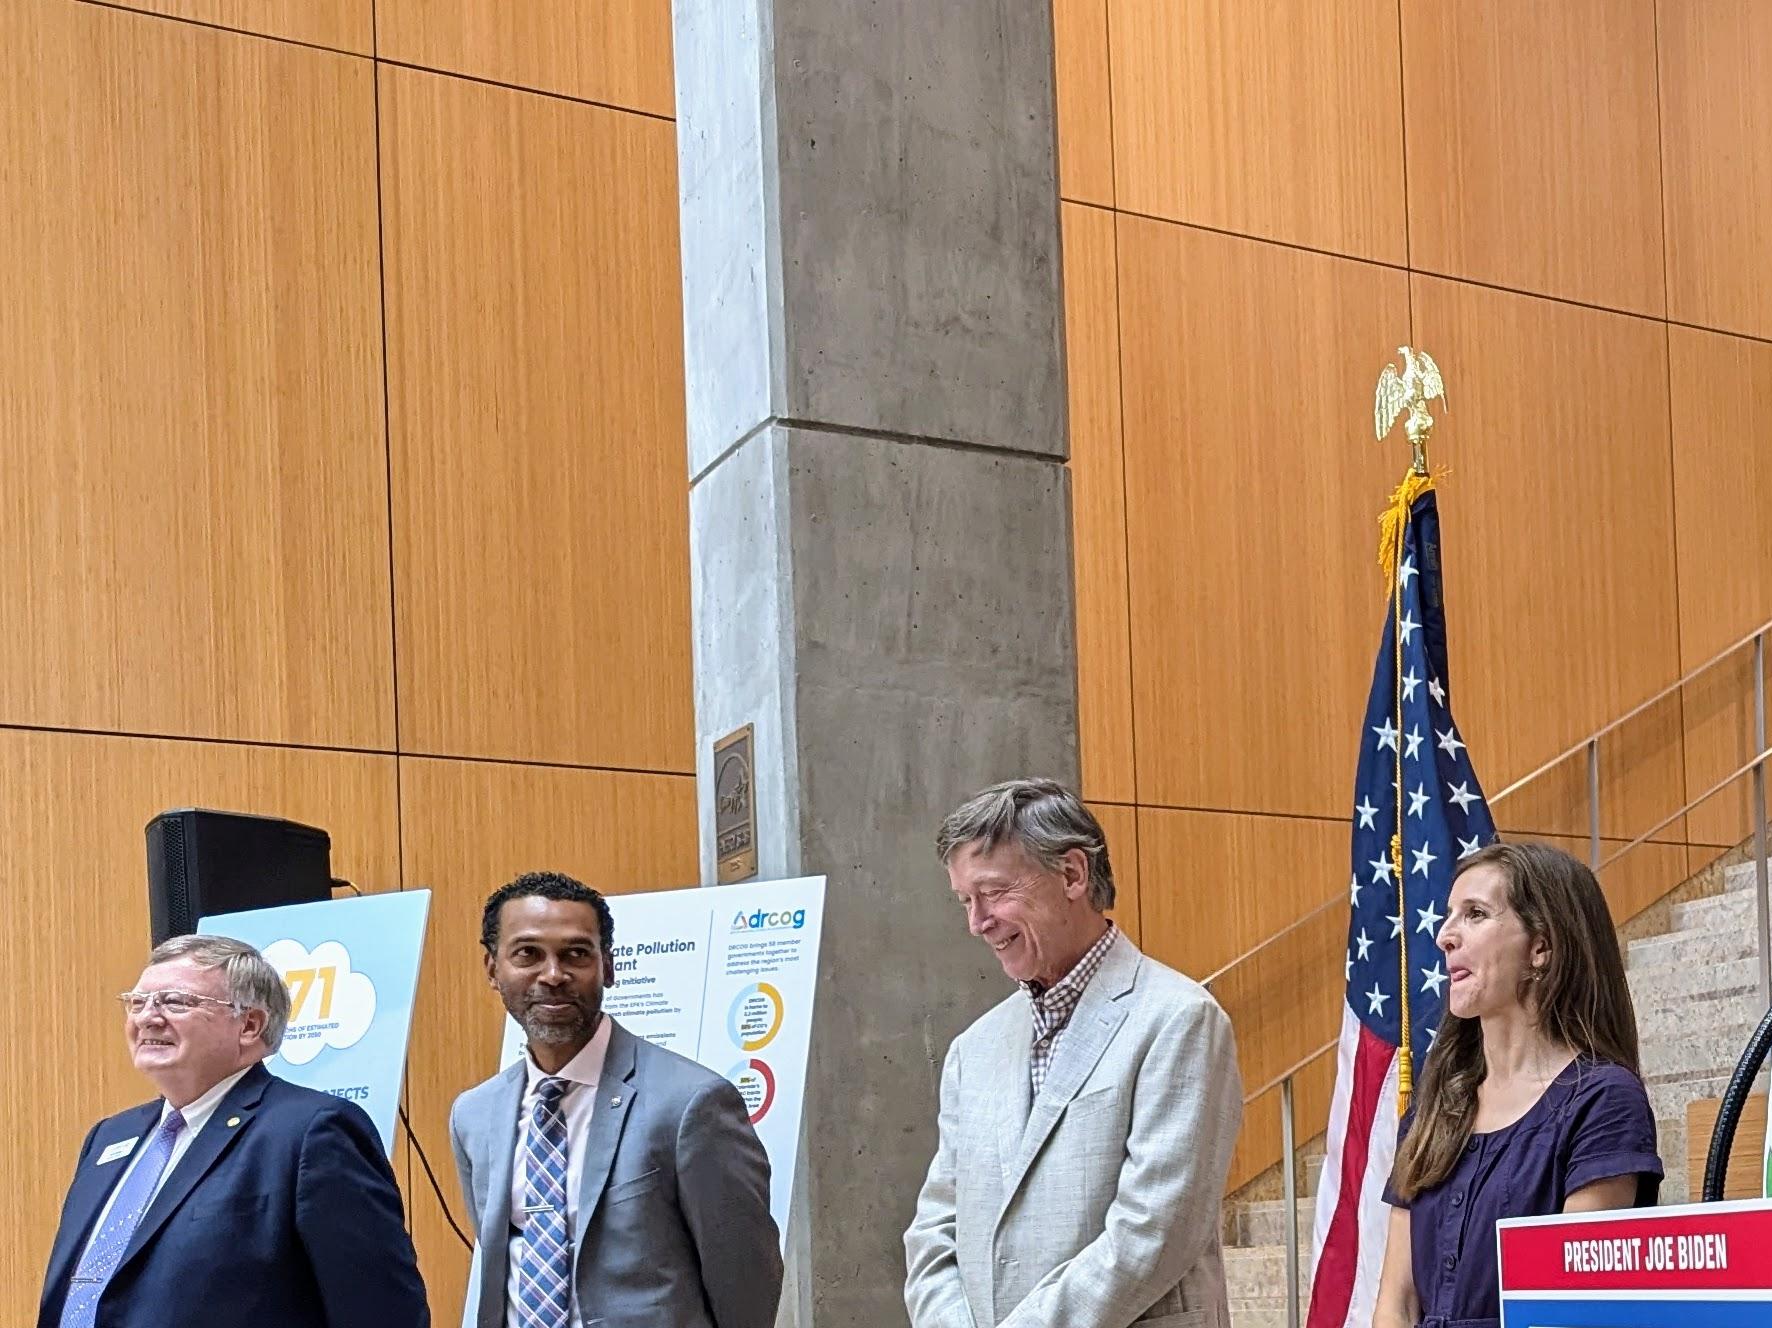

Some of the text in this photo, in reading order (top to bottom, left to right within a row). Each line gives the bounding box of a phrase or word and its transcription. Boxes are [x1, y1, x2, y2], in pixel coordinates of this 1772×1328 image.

[749, 908, 805, 929] drcog
[612, 939, 695, 957] ate Pollution
[728, 943, 748, 951] DRCOG
[728, 951, 764, 960] governments
[765, 948, 789, 956] together
[614, 959, 637, 971] ant
[761, 957, 783, 965] region's
[615, 976, 656, 988] g Initiative
[284, 966, 336, 1022] 71
[613, 993, 651, 1001] Governments
[646, 1008, 673, 1016] pollution
[307, 1022, 339, 1031] ESTIMATED
[327, 1086, 369, 1100] JECTS
[1563, 1233, 1727, 1272] PRESIDENT JOE BIDEN
